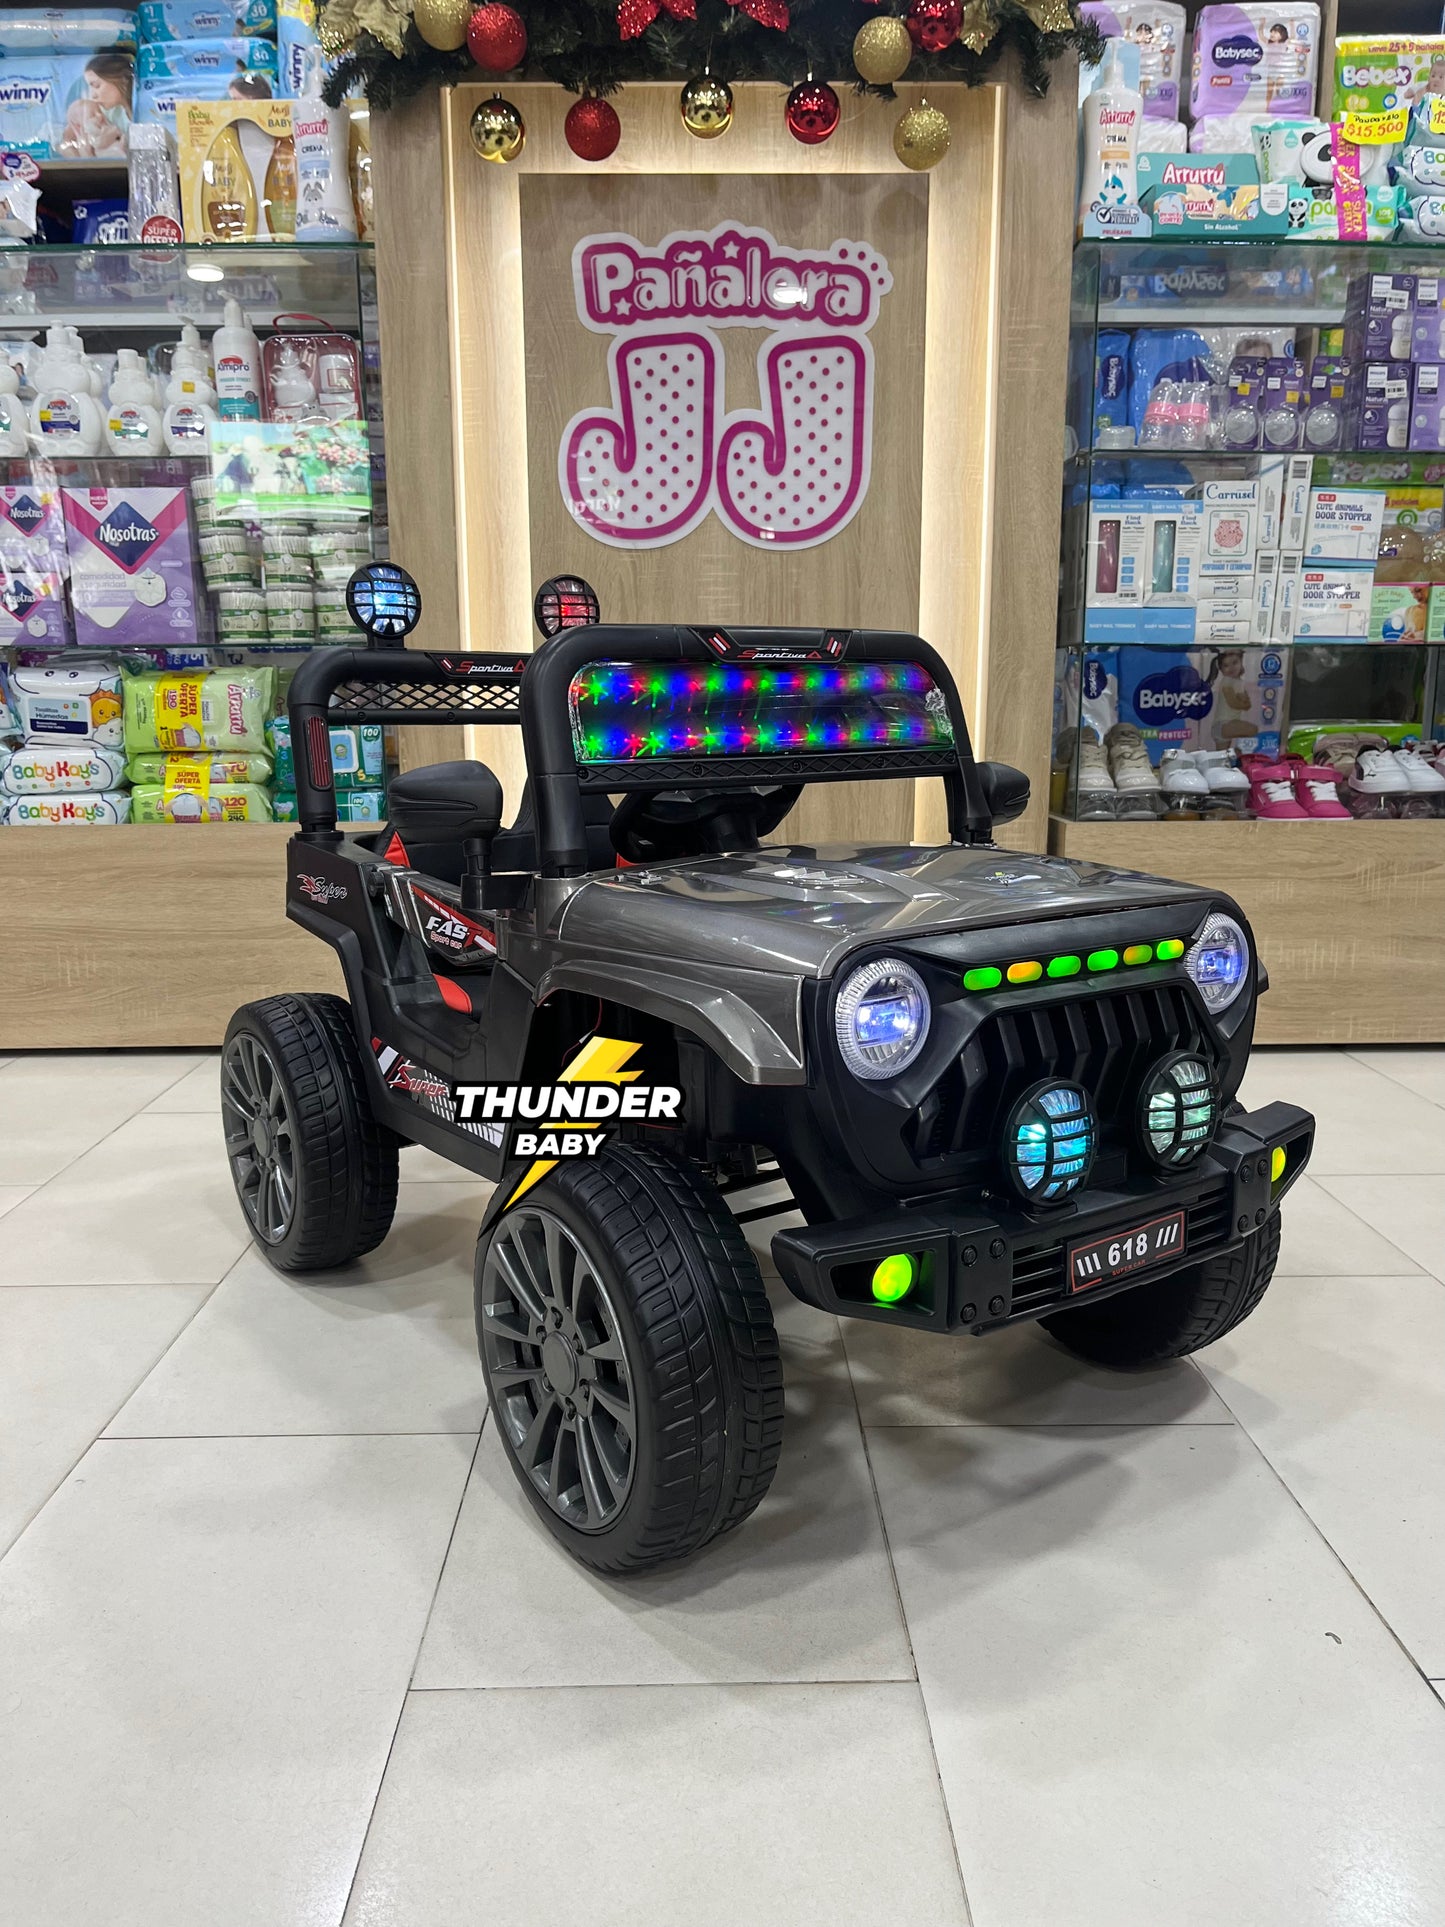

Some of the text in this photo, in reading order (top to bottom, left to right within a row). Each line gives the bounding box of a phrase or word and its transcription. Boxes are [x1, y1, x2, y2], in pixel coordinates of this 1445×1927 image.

[1214, 45, 1261, 61] Babysec
[289, 43, 306, 89] winny
[1342, 65, 1411, 88] Bebex
[0, 83, 49, 104] winny
[267, 118, 293, 129] BABY
[1346, 121, 1404, 138] $15.500
[1163, 161, 1226, 185] Arrurrú
[147, 226, 177, 236] SUPER
[582, 240, 867, 322] Pañalera
[567, 332, 867, 544] JJ
[1206, 483, 1257, 500] Carrusel
[10, 508, 44, 519] Nosotras
[1315, 511, 1372, 522] DOOR STOPPER
[1316, 503, 1364, 512] CUTE ANIMALS
[100, 521, 157, 543] Nosotras
[1303, 591, 1324, 599] DOOR
[179, 682, 189, 718] OFERTA
[227, 683, 248, 735] Arrurrú
[1139, 689, 1208, 710] Babysec
[35, 711, 69, 720] Húmedas
[362, 728, 379, 737] 100
[1158, 728, 1192, 740] PROTECT
[12, 761, 100, 782] Baby Kay's
[17, 802, 105, 823] Baby Kay's
[224, 797, 247, 807] 120
[425, 915, 482, 948] FAST
[1108, 1233, 1148, 1267] 618
